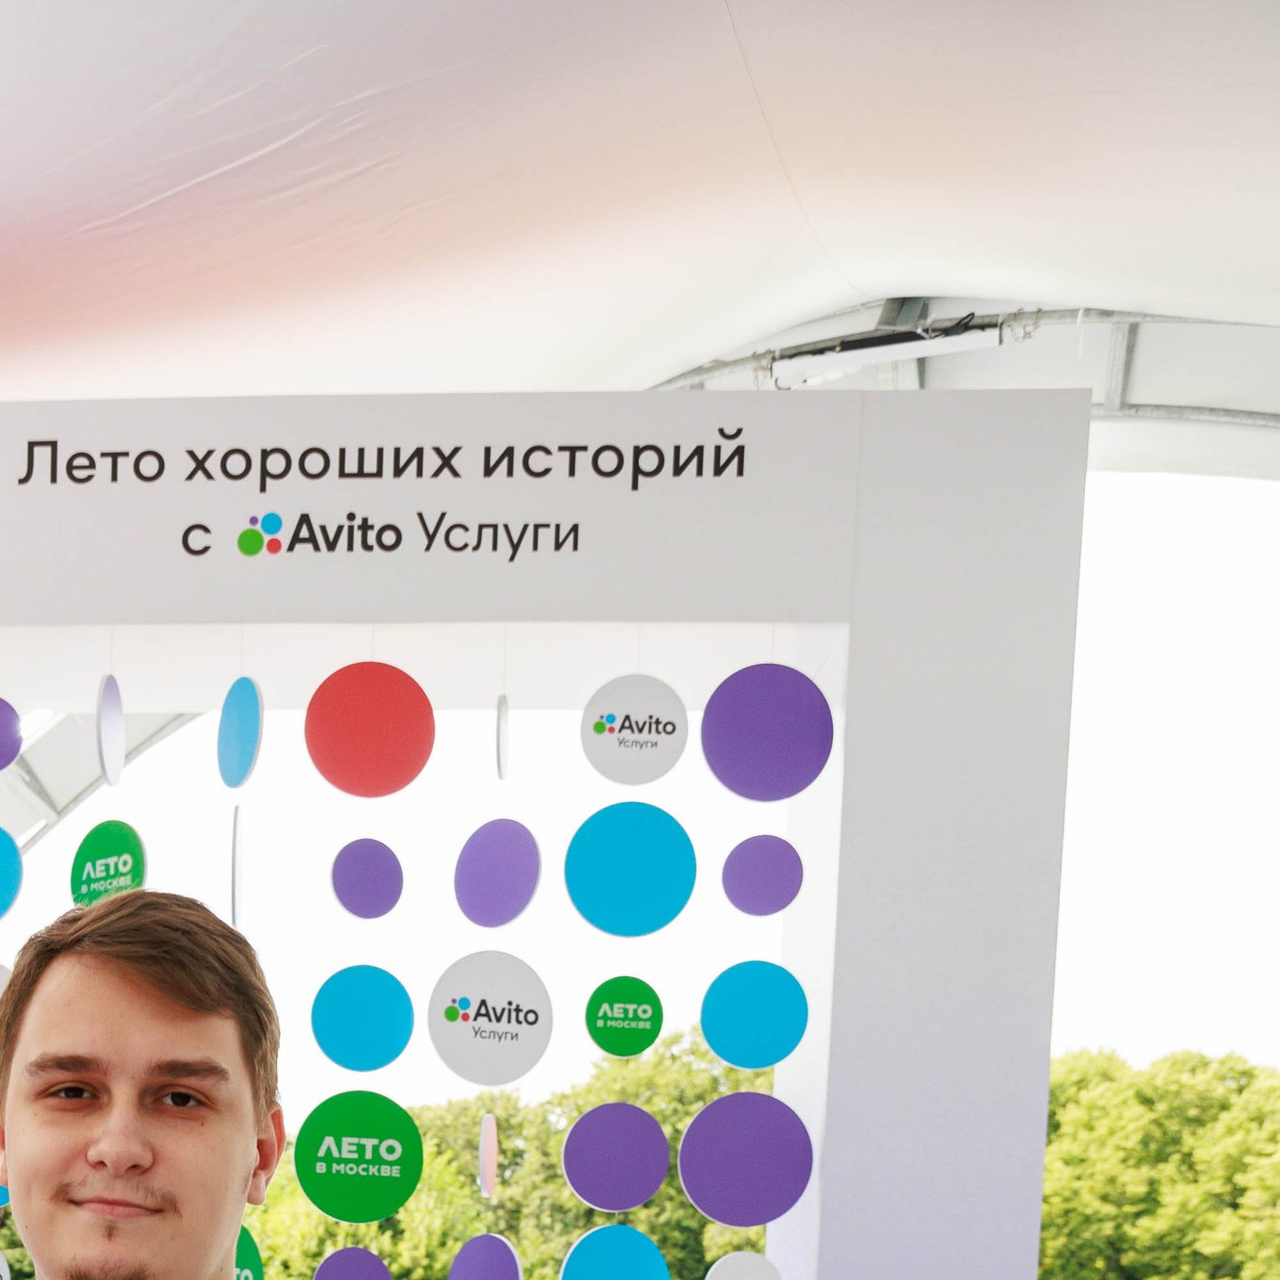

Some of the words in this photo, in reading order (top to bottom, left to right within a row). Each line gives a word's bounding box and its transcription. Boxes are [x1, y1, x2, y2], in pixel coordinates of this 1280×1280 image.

[18, 439, 166, 485] Лето
[184, 445, 463, 494] хороших
[483, 427, 746, 491] историй
[181, 523, 212, 557] с
[286, 512, 404, 553] Avito
[417, 512, 580, 563] Услуги
[618, 714, 676, 735] Avito
[617, 737, 659, 751] Услуги
[472, 998, 539, 1026] Avito
[598, 1002, 653, 1020] ЛЕТО
[472, 1026, 519, 1043] Услуги
[317, 1135, 403, 1162] ЛЕТО
[315, 1161, 327, 1174] В
[332, 1162, 401, 1178] МОСКВЕ
